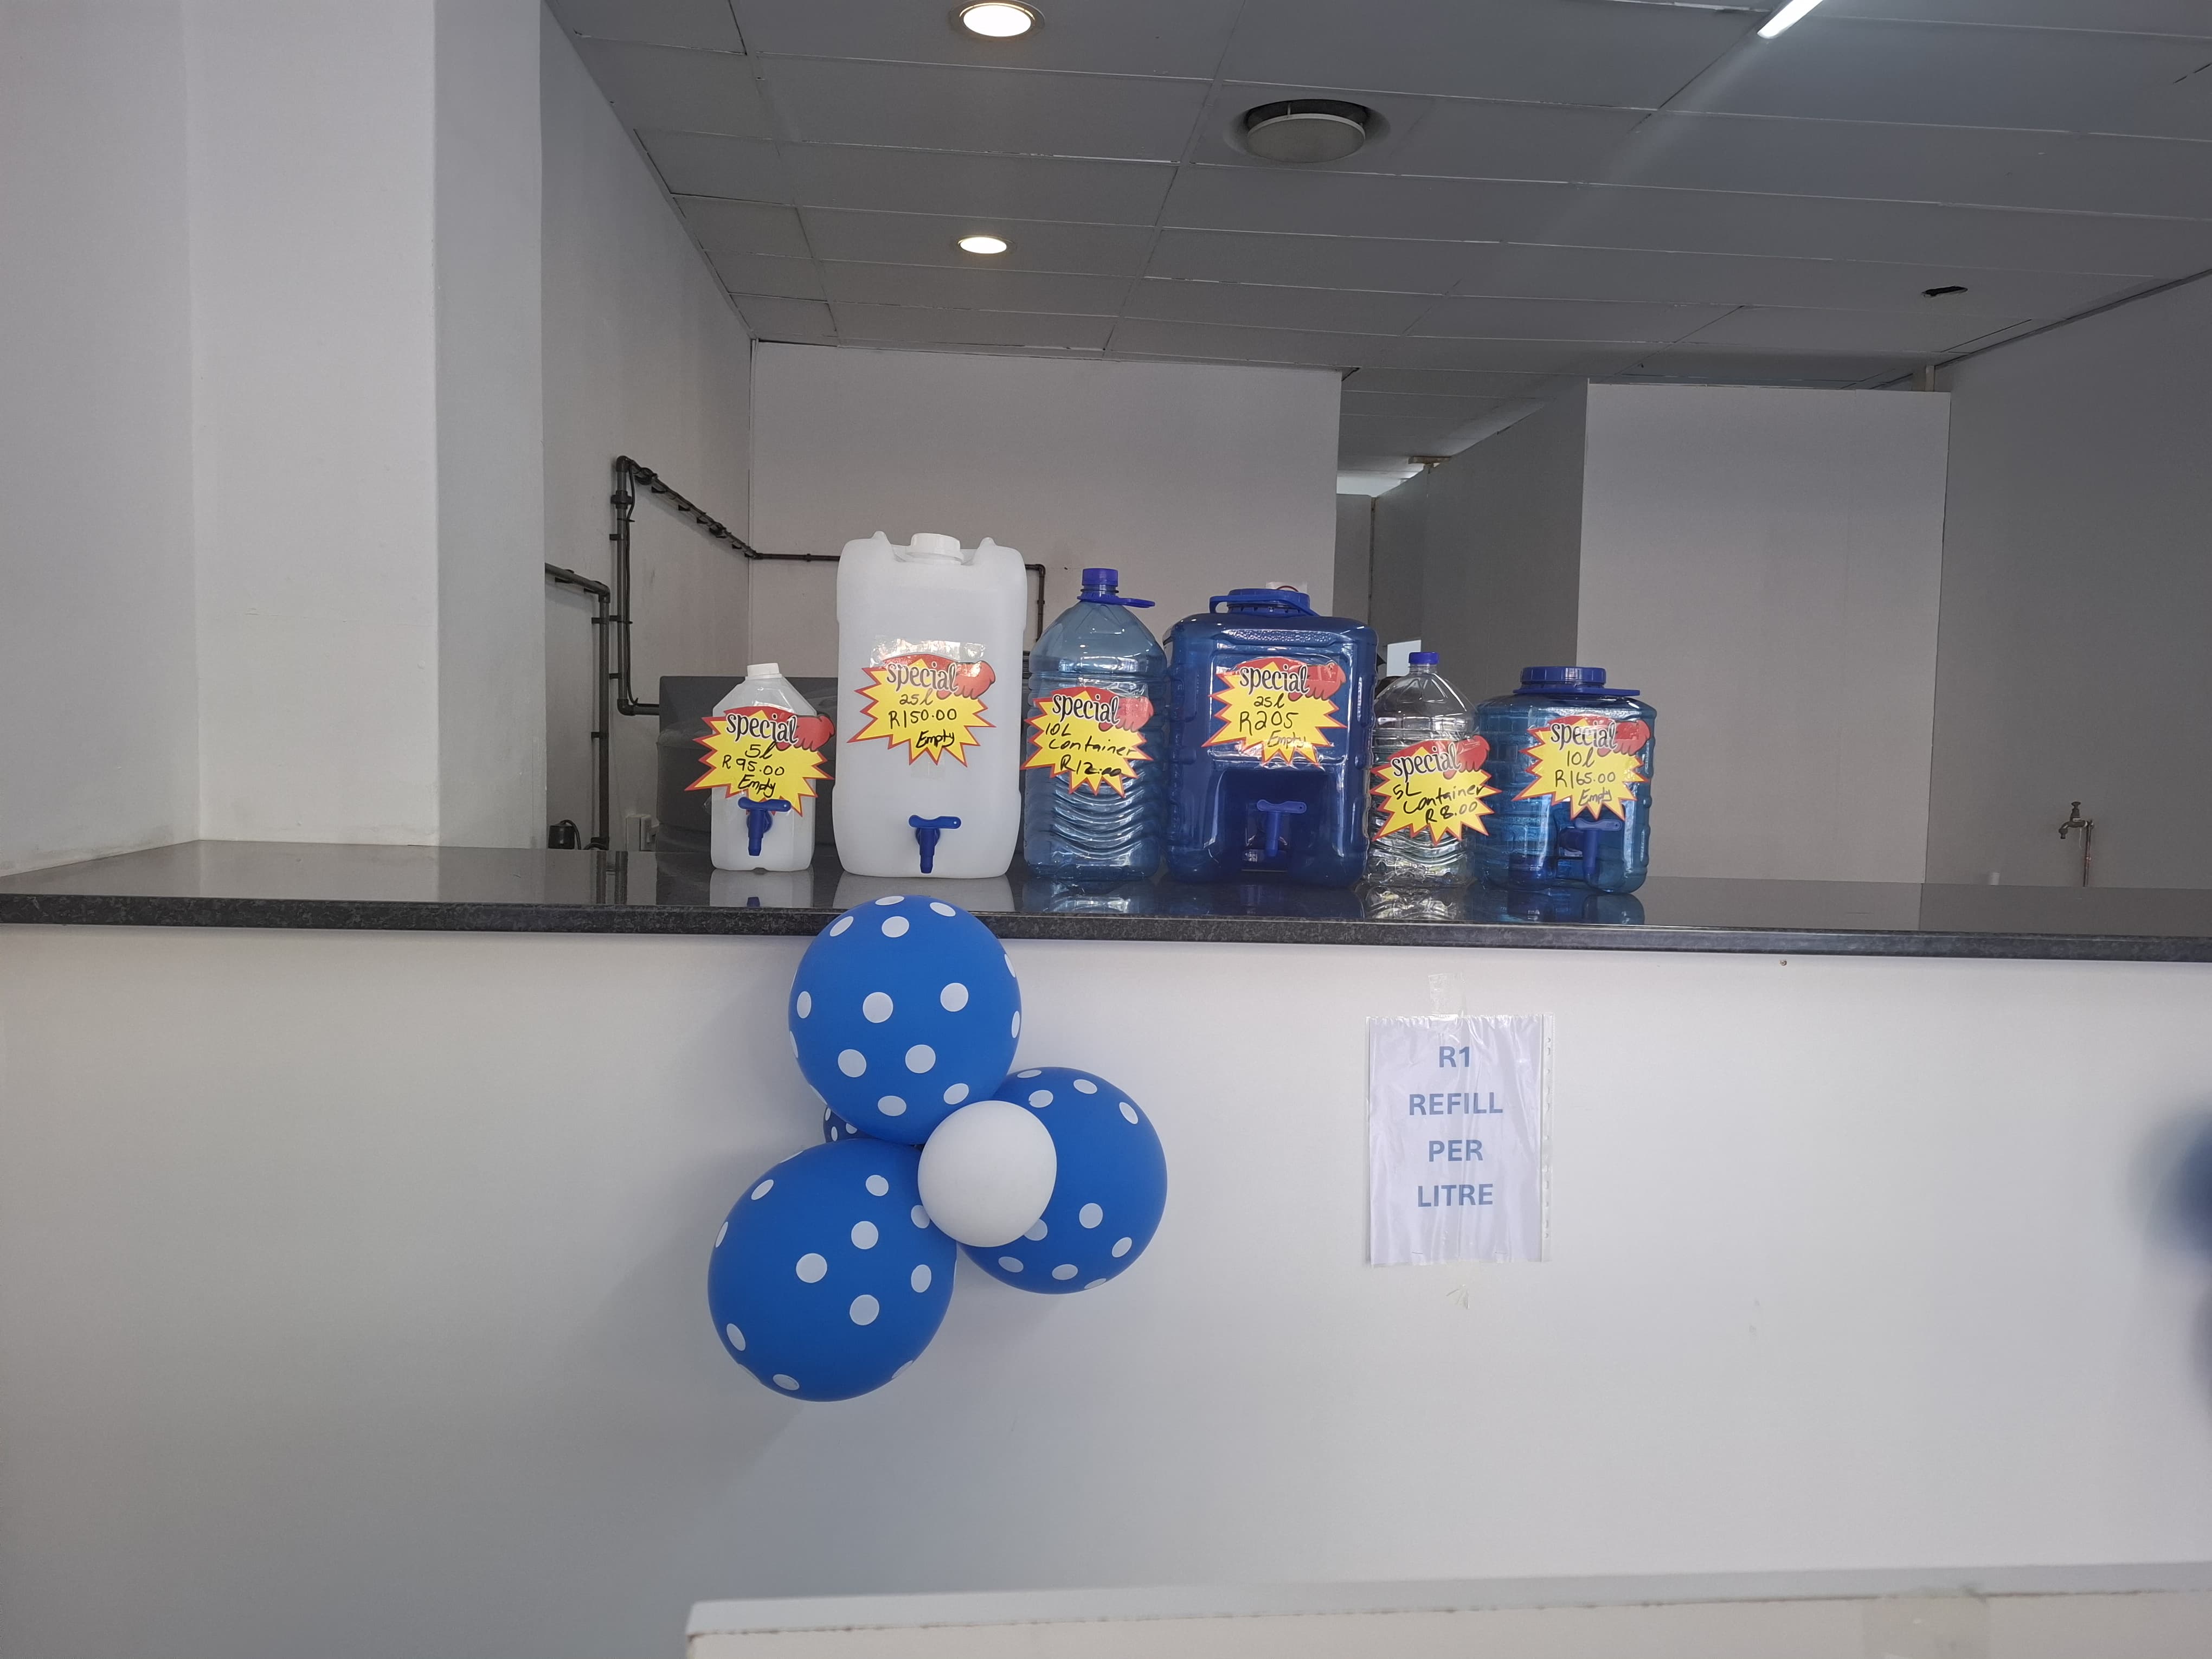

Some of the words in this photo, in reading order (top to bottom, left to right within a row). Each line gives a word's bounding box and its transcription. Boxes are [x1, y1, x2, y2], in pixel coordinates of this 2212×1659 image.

[886, 663, 957, 692] special
[1239, 664, 1309, 695] special
[888, 709, 957, 729] R150.00
[1052, 695, 1120, 724] special
[726, 713, 798, 744] special
[1045, 723, 1071, 737] 10L
[1239, 711, 1299, 736] R205
[915, 729, 955, 748] Empty
[1267, 730, 1306, 749] Empty
[1551, 721, 1618, 751] special
[1392, 743, 1461, 783] special
[738, 774, 776, 798] Empty
[1555, 769, 1616, 789] R165.00
[1392, 782, 1422, 800] 5L
[1578, 787, 1612, 806] Empty
[1439, 1046, 1471, 1068] R1
[1409, 1092, 1503, 1115] REFILL
[1428, 1139, 1483, 1162] PER
[1417, 1184, 1494, 1207] LITRE
